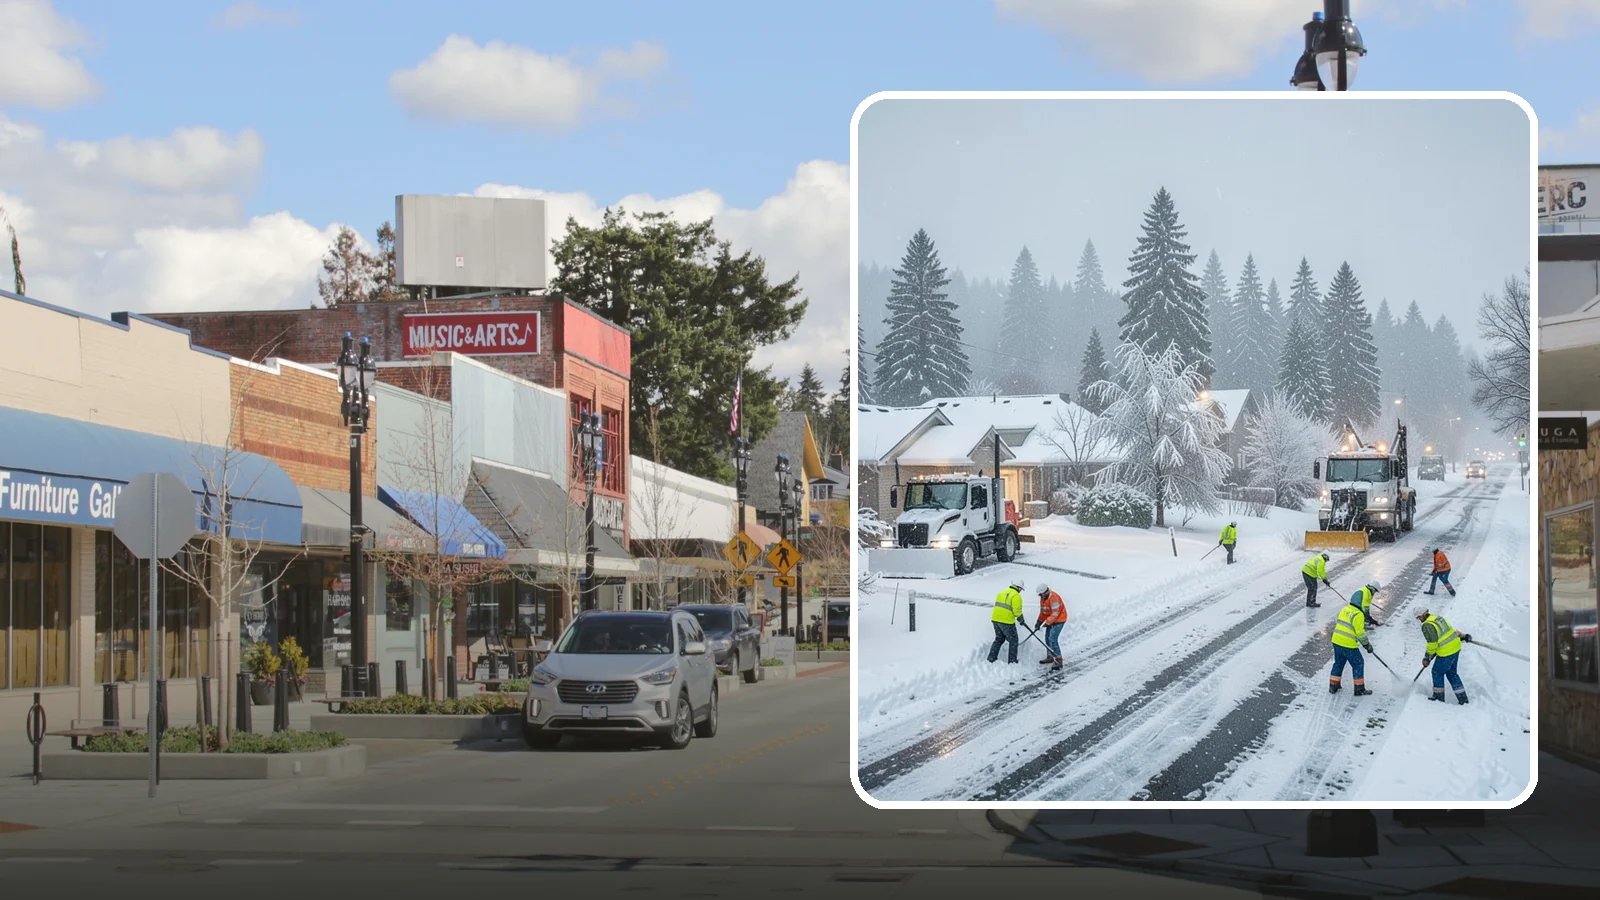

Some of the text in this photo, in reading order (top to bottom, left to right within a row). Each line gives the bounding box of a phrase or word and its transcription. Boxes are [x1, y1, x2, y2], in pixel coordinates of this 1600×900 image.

[409, 322, 519, 349] MUSIC&ARTS
[1540, 427, 1577, 436] UGA
[1552, 436, 1579, 444] Framing
[0, 471, 121, 519] Furniture Gal
[454, 563, 479, 574] SUSHI
